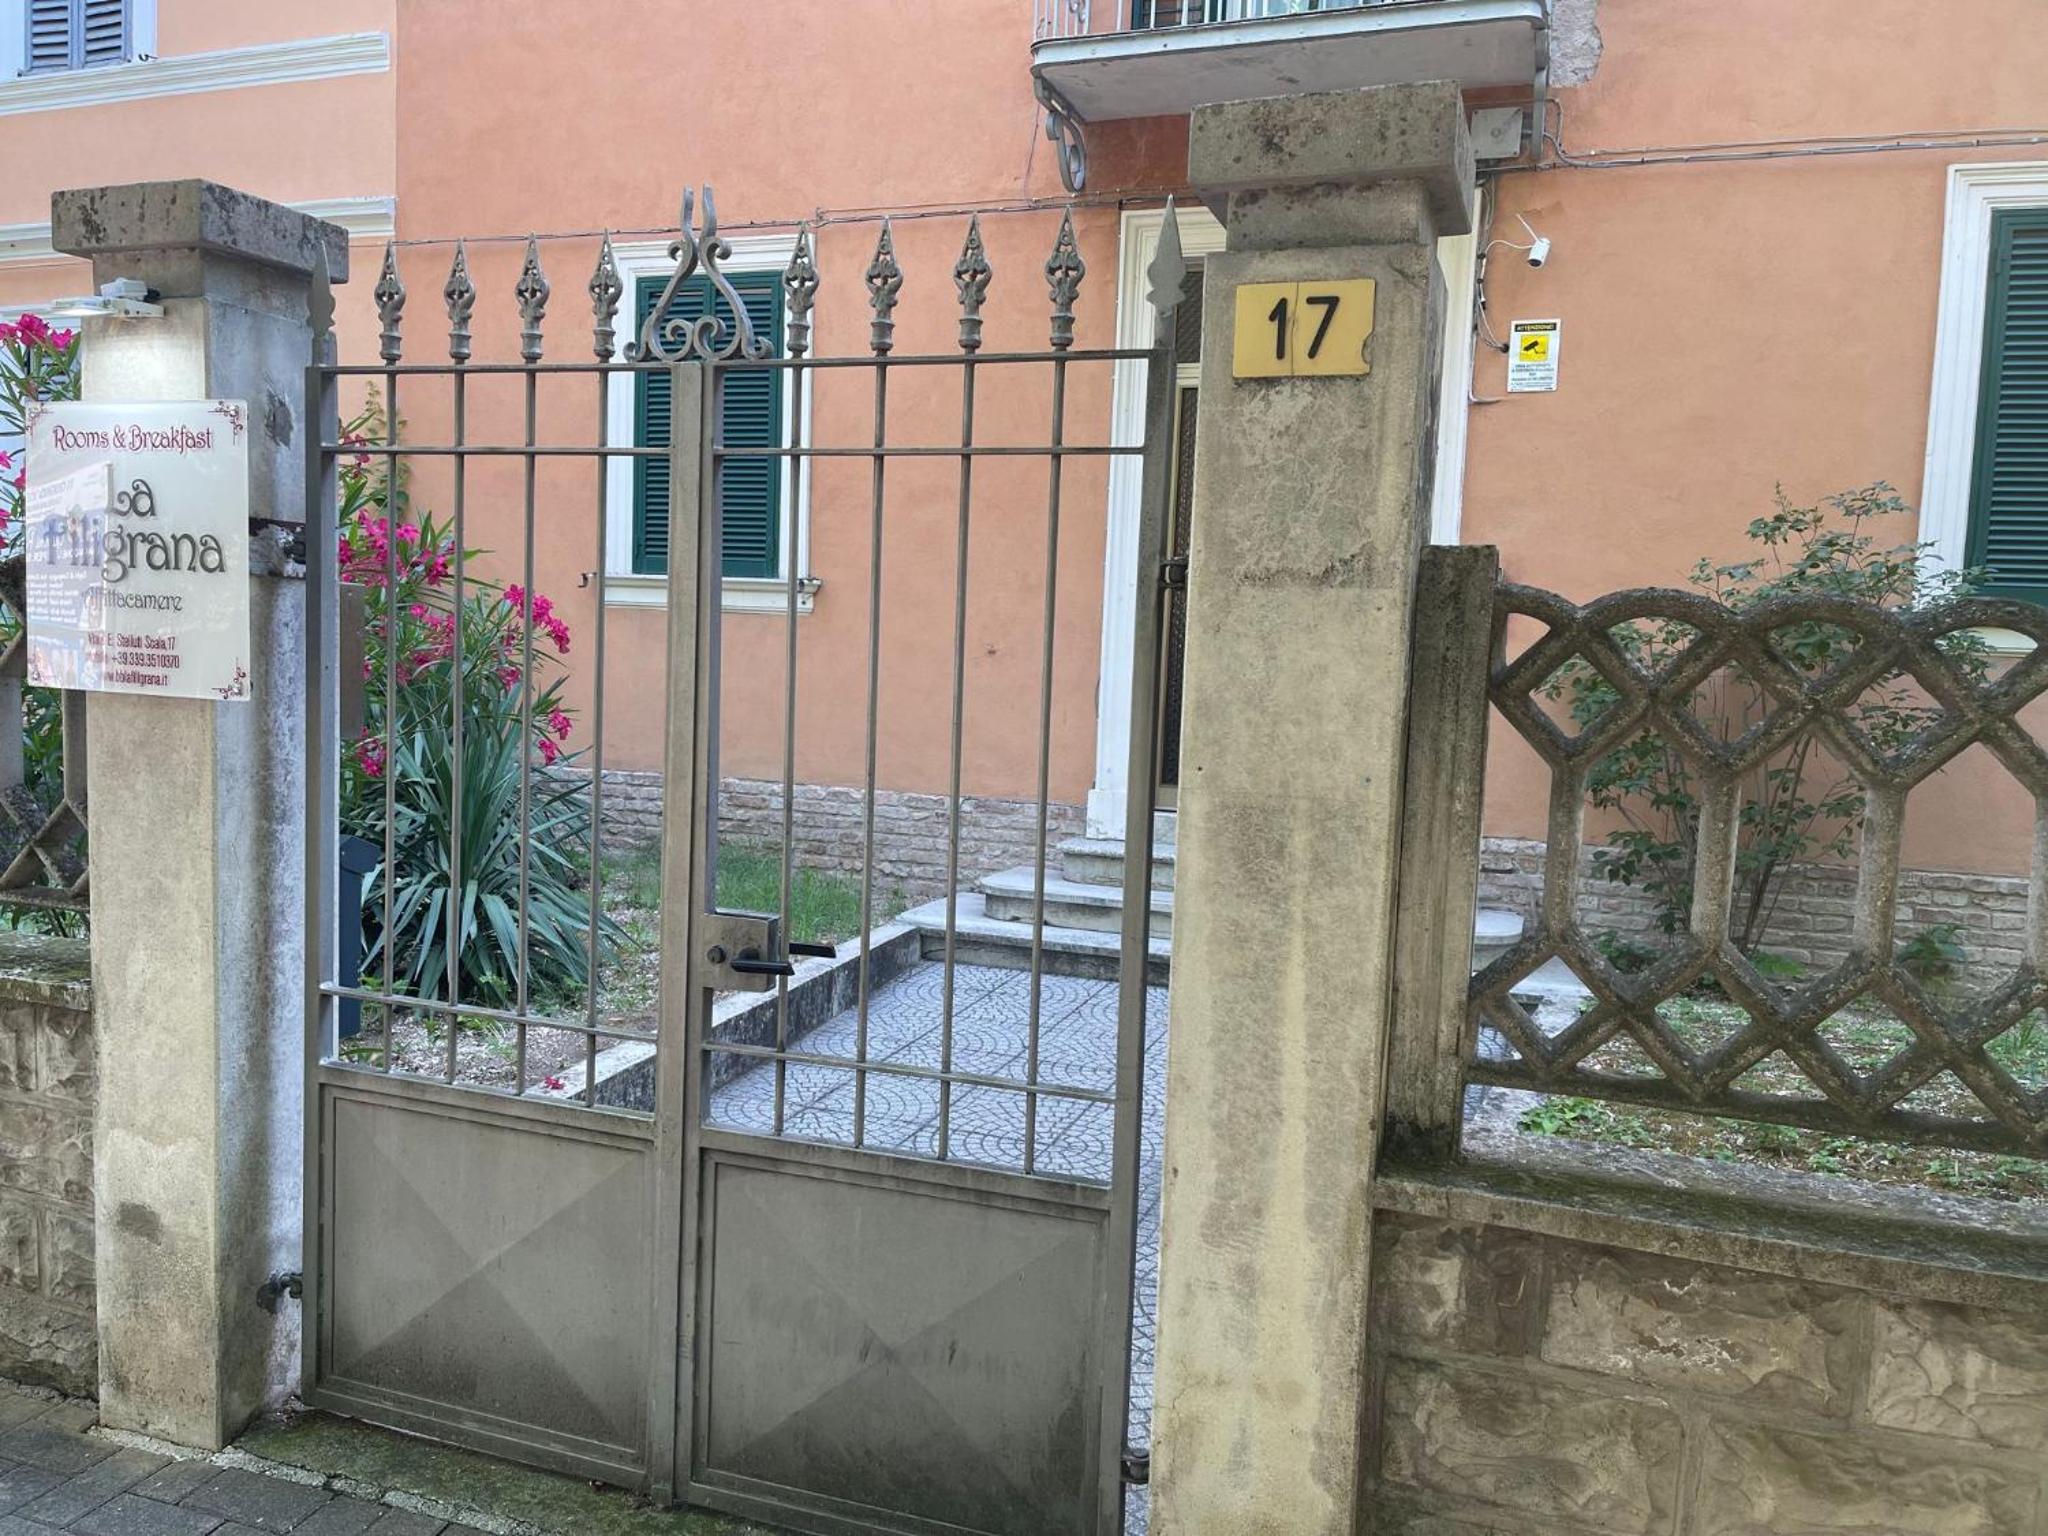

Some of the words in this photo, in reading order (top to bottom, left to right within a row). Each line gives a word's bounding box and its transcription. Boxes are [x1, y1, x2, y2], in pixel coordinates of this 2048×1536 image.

[1268, 295, 1340, 360] 17
[53, 425, 109, 452] Rooms
[112, 425, 127, 449] &
[128, 424, 213, 455] Breakfast
[104, 463, 156, 518] La
